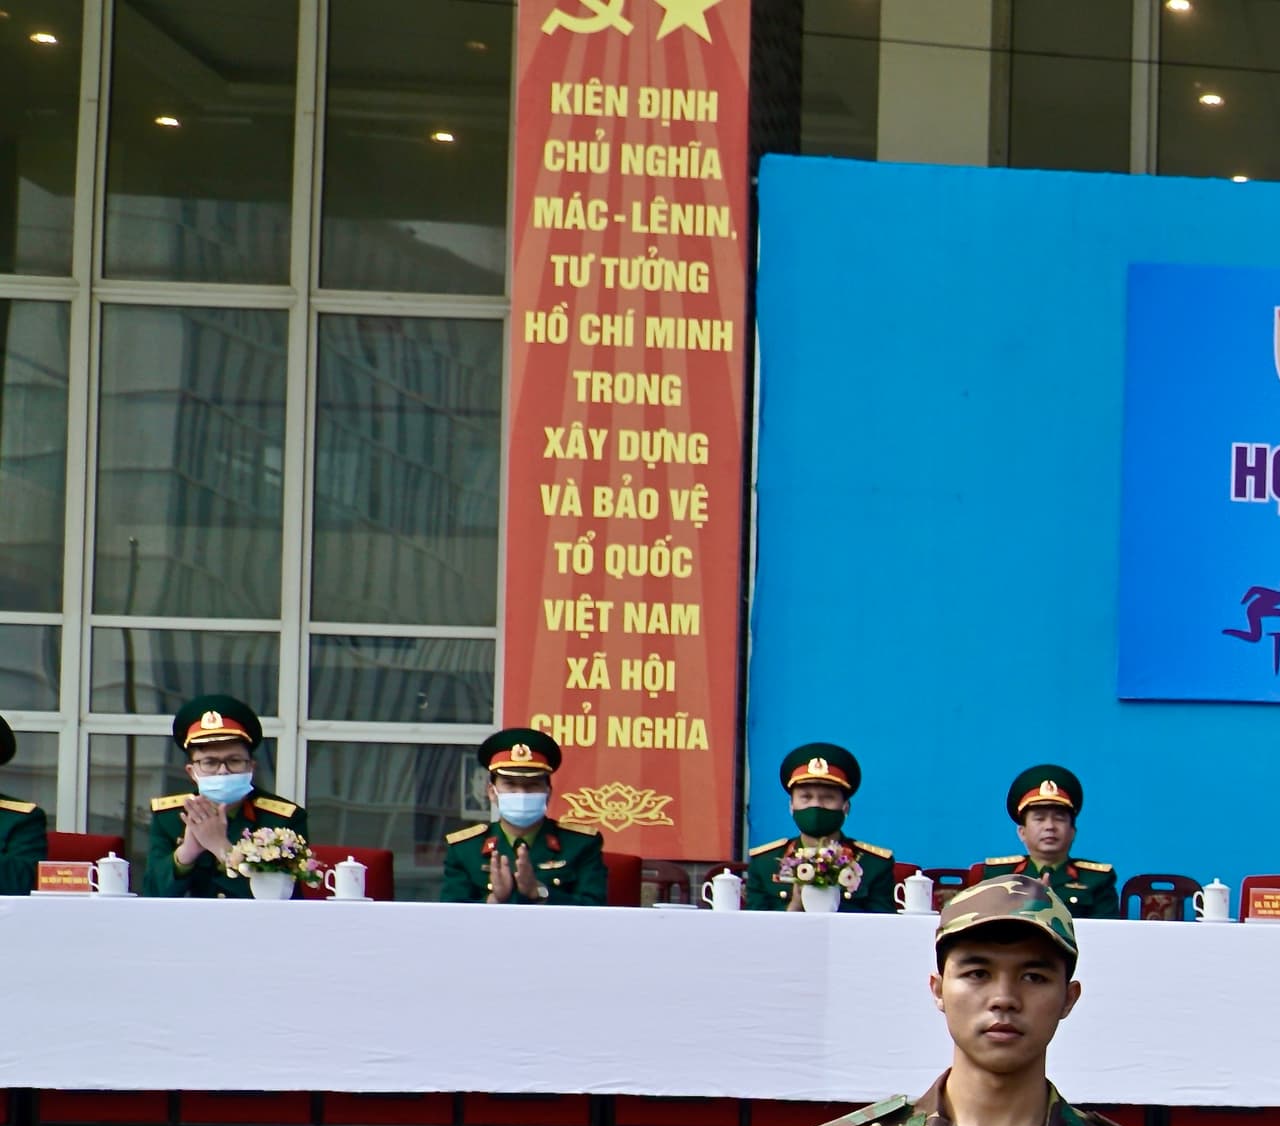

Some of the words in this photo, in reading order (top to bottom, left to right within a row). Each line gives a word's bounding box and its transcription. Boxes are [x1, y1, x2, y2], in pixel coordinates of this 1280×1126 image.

[551, 78, 627, 117] KIÊN
[639, 87, 718, 127] ĐỊNH
[544, 129, 609, 174] CHỦ
[621, 141, 722, 180] NGHĨA
[533, 193, 608, 232] MÁC
[632, 196, 737, 240] LÊNIN,
[551, 253, 595, 288] TƯ
[601, 247, 709, 293] TƯỞNG
[525, 302, 569, 344] HỒ
[579, 311, 634, 347] CHÍ
[645, 317, 733, 351] MINH
[573, 371, 681, 406] TRONG
[544, 422, 608, 459] XÂY
[619, 429, 708, 469] DỰNG
[541, 480, 582, 516] VÀ
[593, 474, 658, 520] BẢO
[670, 484, 708, 528] VỆ
[554, 530, 596, 575] TỔ
[605, 535, 693, 580] QUỐC
[544, 594, 613, 639] VIỆT
[624, 603, 699, 635] NAM
[566, 652, 610, 690] XÃ
[622, 654, 675, 698] HỘI
[530, 701, 597, 747] CHỦ
[608, 712, 708, 750] NGHĨA
